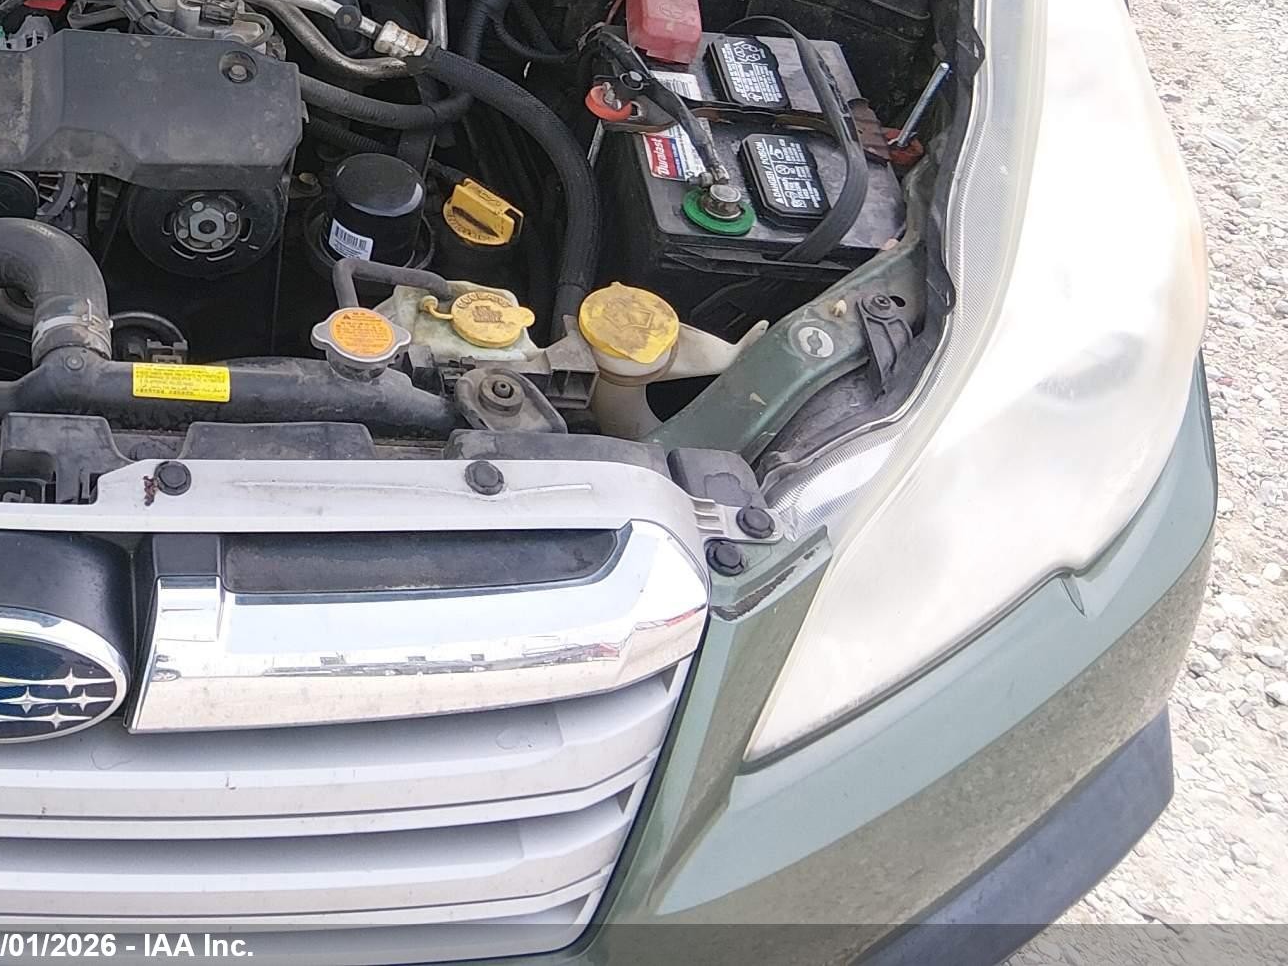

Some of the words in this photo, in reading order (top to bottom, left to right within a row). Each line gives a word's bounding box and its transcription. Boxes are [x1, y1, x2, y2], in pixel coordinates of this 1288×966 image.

[651, 137, 670, 175] Duralast
[754, 141, 770, 165] POISON
[765, 170, 782, 197] DANGER
